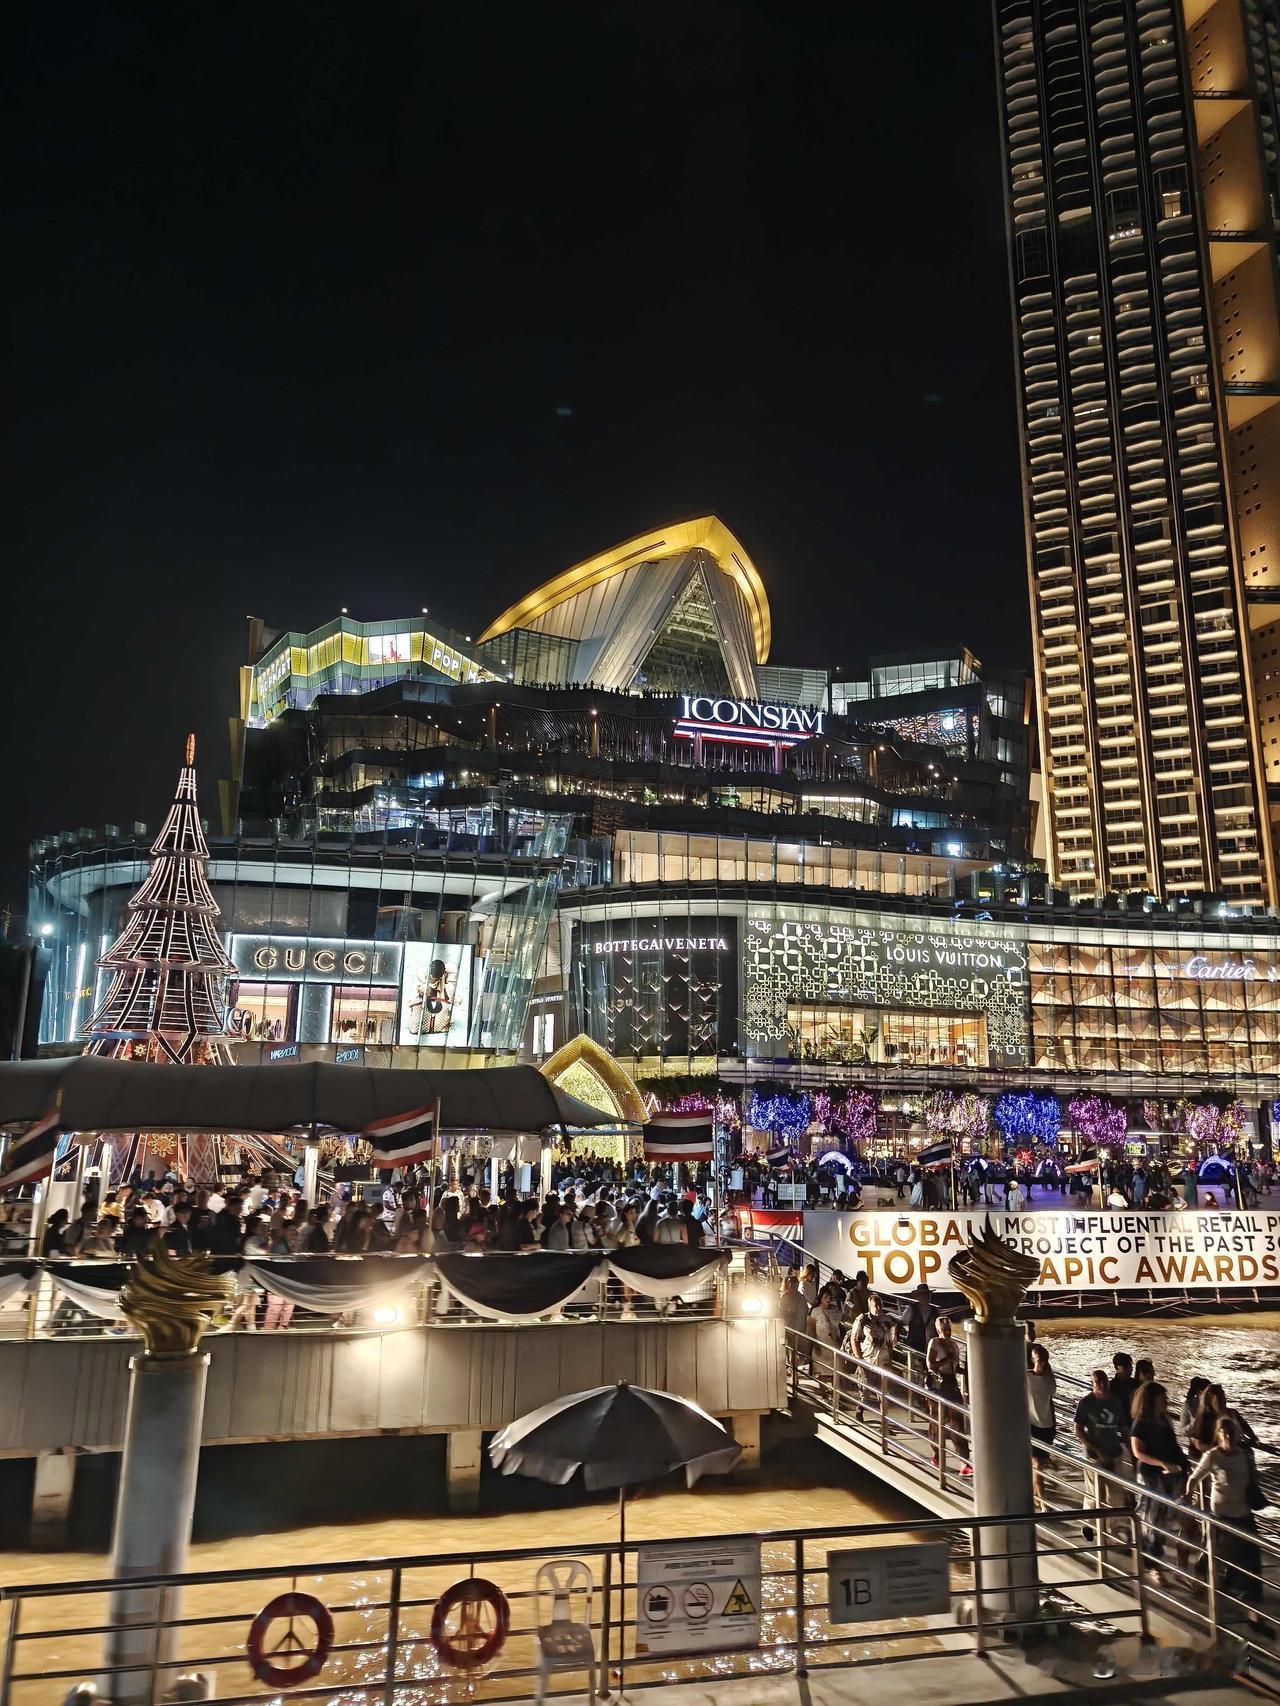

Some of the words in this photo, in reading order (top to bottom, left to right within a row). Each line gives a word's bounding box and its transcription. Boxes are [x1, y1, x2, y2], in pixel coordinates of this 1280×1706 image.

[433, 648, 460, 671] POP
[681, 695, 825, 735] ICONSIAM
[595, 939, 659, 954] BOTTEGA
[663, 937, 728, 951] VENETA
[886, 946, 930, 963] LOUIS
[935, 950, 1002, 968] VUITTON
[254, 947, 380, 974] GUCCI
[1185, 956, 1256, 982] Cartier
[1004, 1216, 1058, 1235] MOST
[1197, 1215, 1263, 1233] RETAIL
[1266, 1215, 1280, 1232] P
[1006, 1235, 1107, 1255] PROJECT
[1117, 1236, 1146, 1254] OF
[1155, 1236, 1195, 1253] THE
[1203, 1235, 1256, 1252] PAST
[1264, 1235, 1280, 1252] 3
[857, 1250, 942, 1285] TOP
[1038, 1256, 1120, 1286] APIC
[1135, 1254, 1279, 1284] AWARDS
[840, 1578, 873, 1607] 1B
